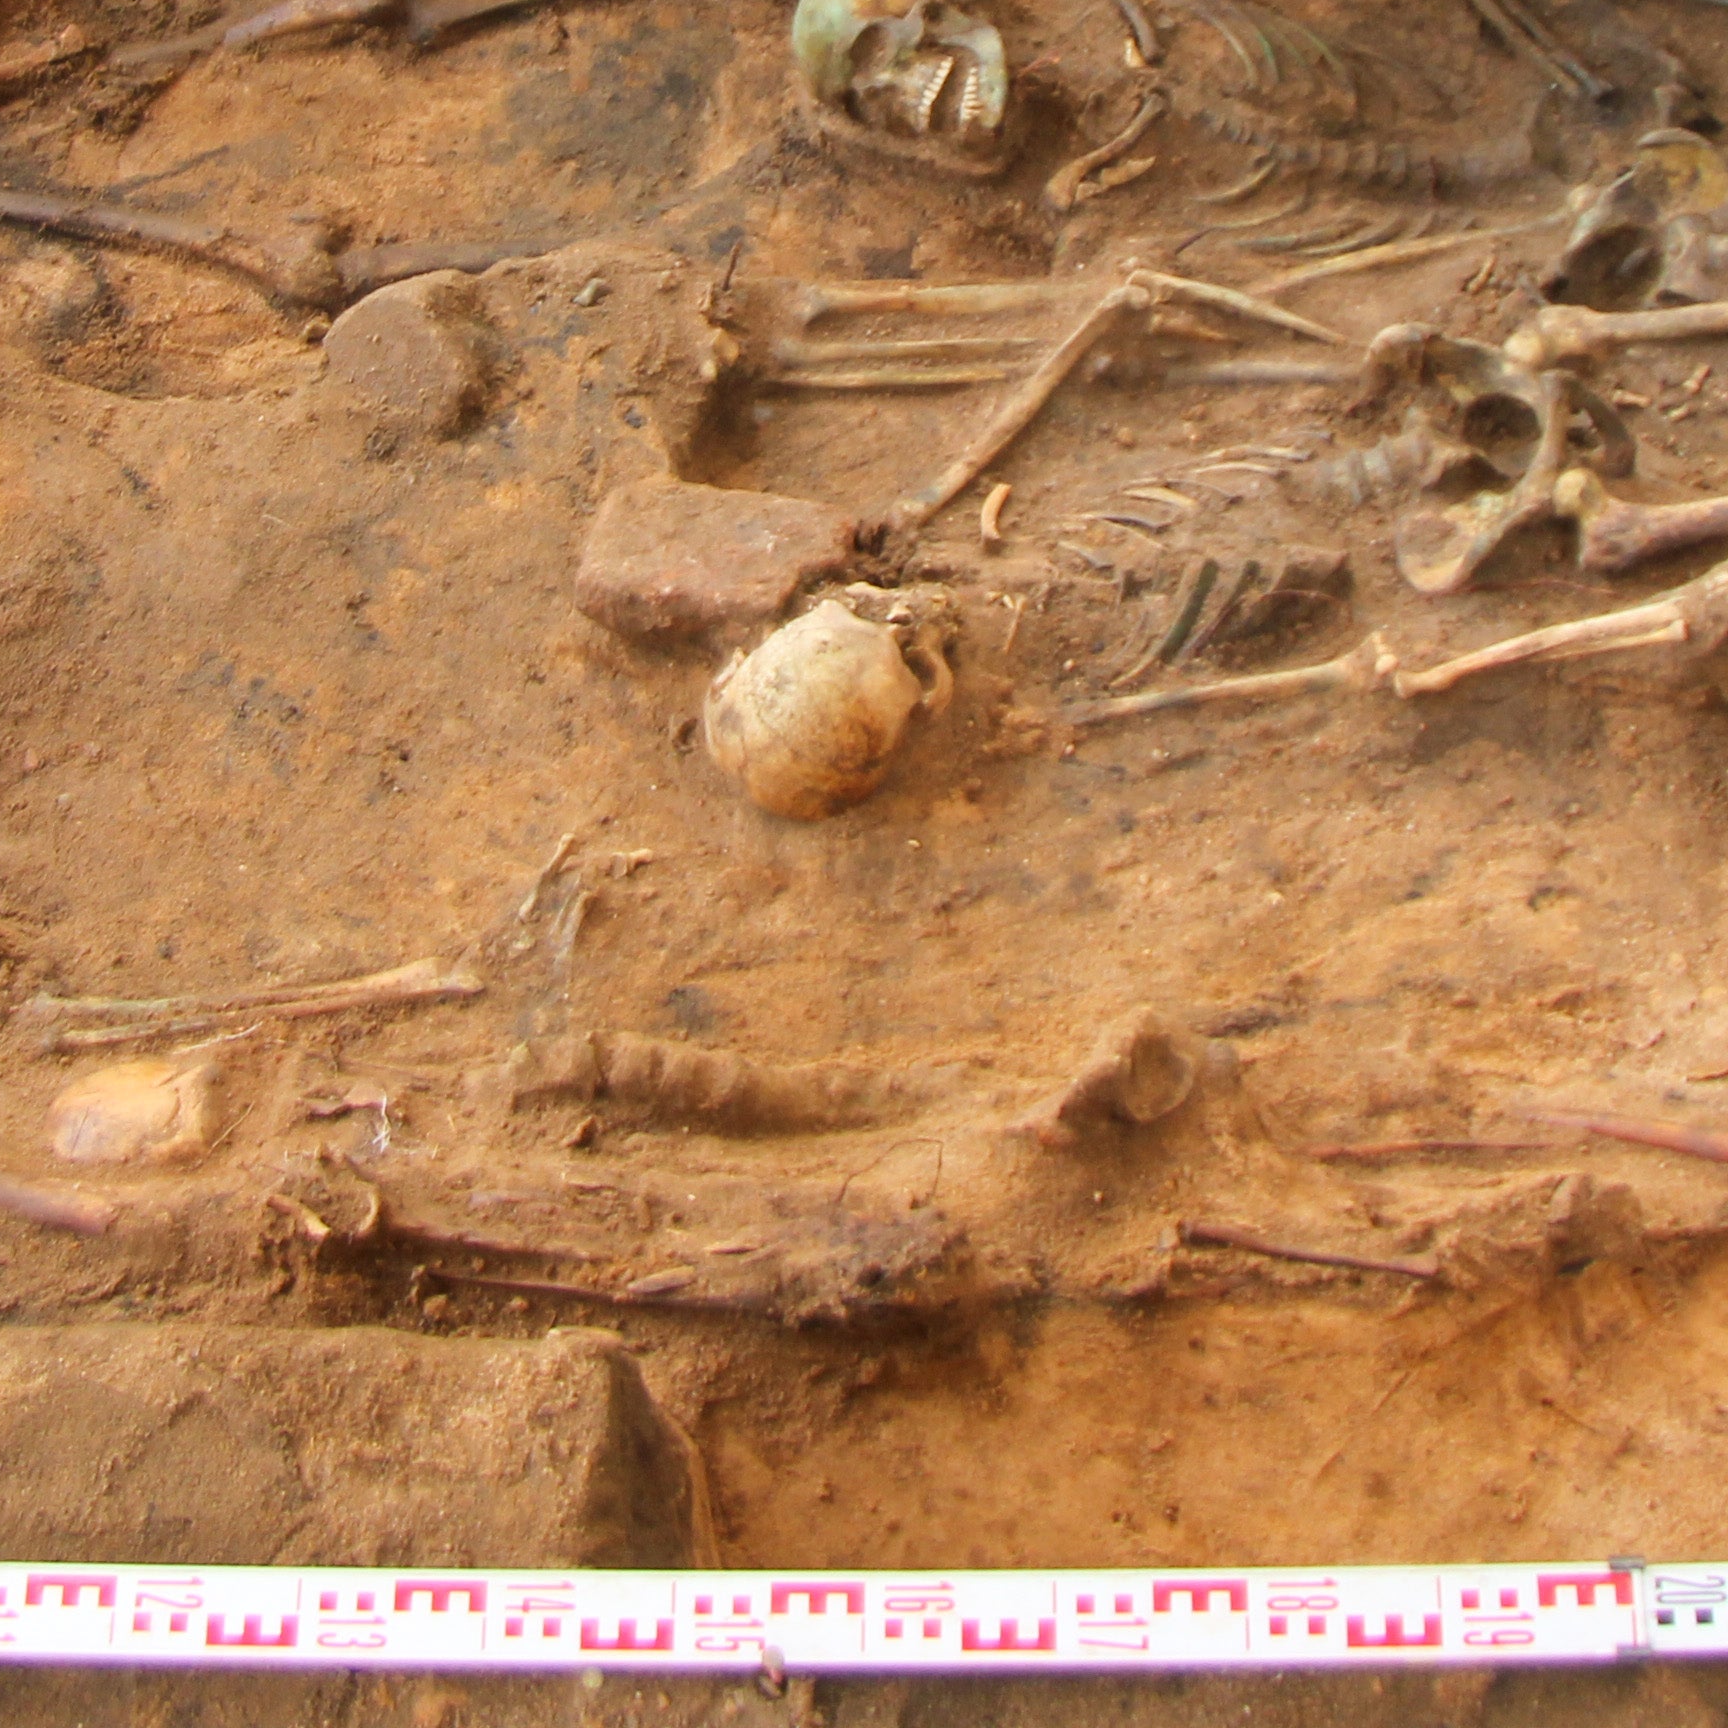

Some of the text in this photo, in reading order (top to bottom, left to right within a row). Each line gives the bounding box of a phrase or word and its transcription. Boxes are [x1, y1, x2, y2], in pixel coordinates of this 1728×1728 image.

[135, 1575, 204, 1612] 12
[504, 1580, 575, 1616] 14
[883, 1578, 955, 1616] 16
[1267, 1575, 1341, 1614] 18
[1653, 1572, 1728, 1607] 20
[317, 1614, 387, 1650] 13
[694, 1616, 766, 1653] 15
[1077, 1614, 1149, 1651] 17
[1462, 1610, 1536, 1647] 19
